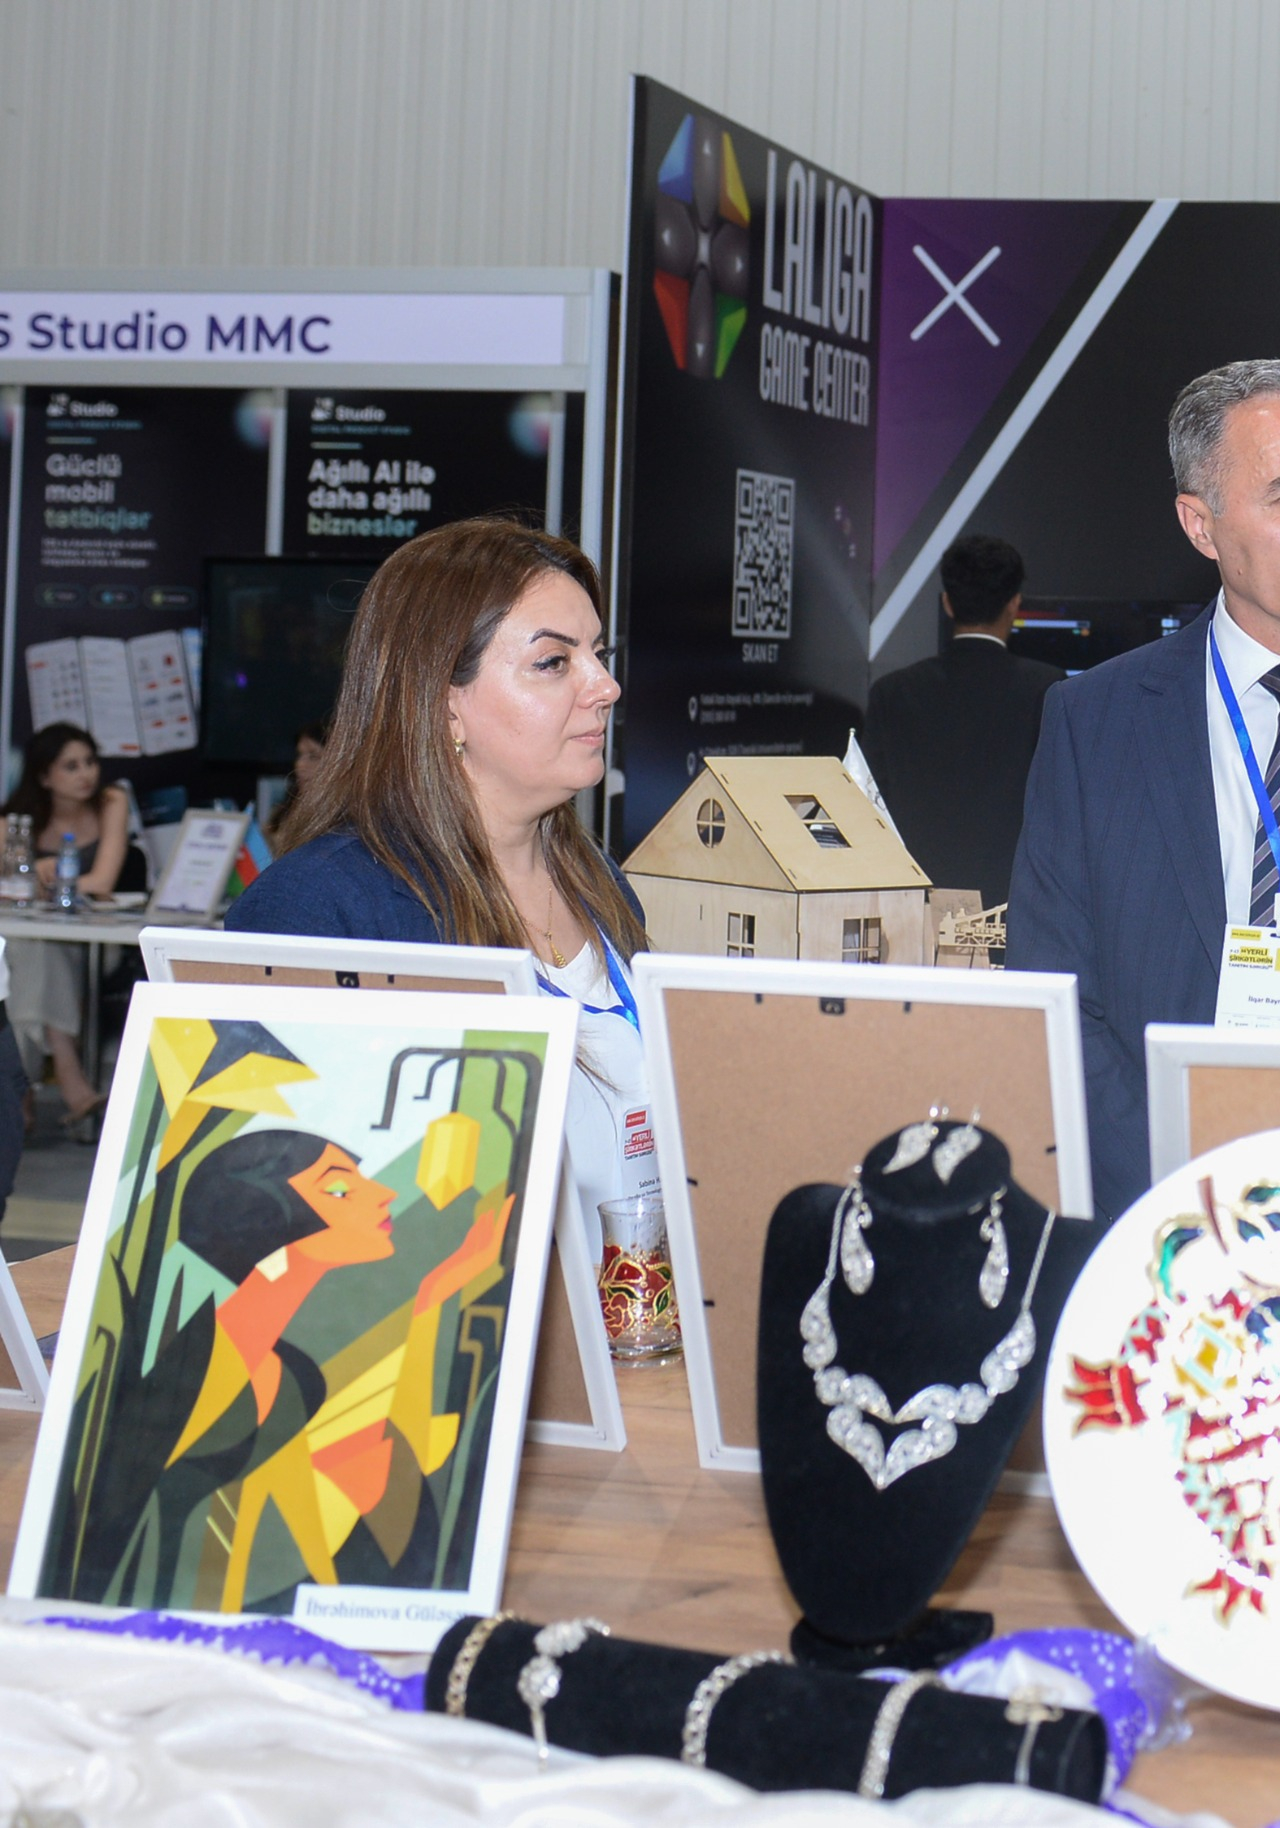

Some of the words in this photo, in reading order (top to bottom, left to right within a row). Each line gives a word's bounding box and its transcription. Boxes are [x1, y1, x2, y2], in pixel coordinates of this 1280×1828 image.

[763, 149, 873, 343] LALIGA
[29, 311, 187, 351] Studio
[207, 315, 331, 353] MMC
[759, 322, 810, 411] GAME
[812, 340, 870, 426] CENTER
[335, 406, 386, 422] Studio
[374, 460, 401, 484] AI
[45, 480, 115, 504] mobil
[307, 486, 369, 510] daha
[742, 643, 766, 663] SKAN
[768, 643, 779, 663] ET
